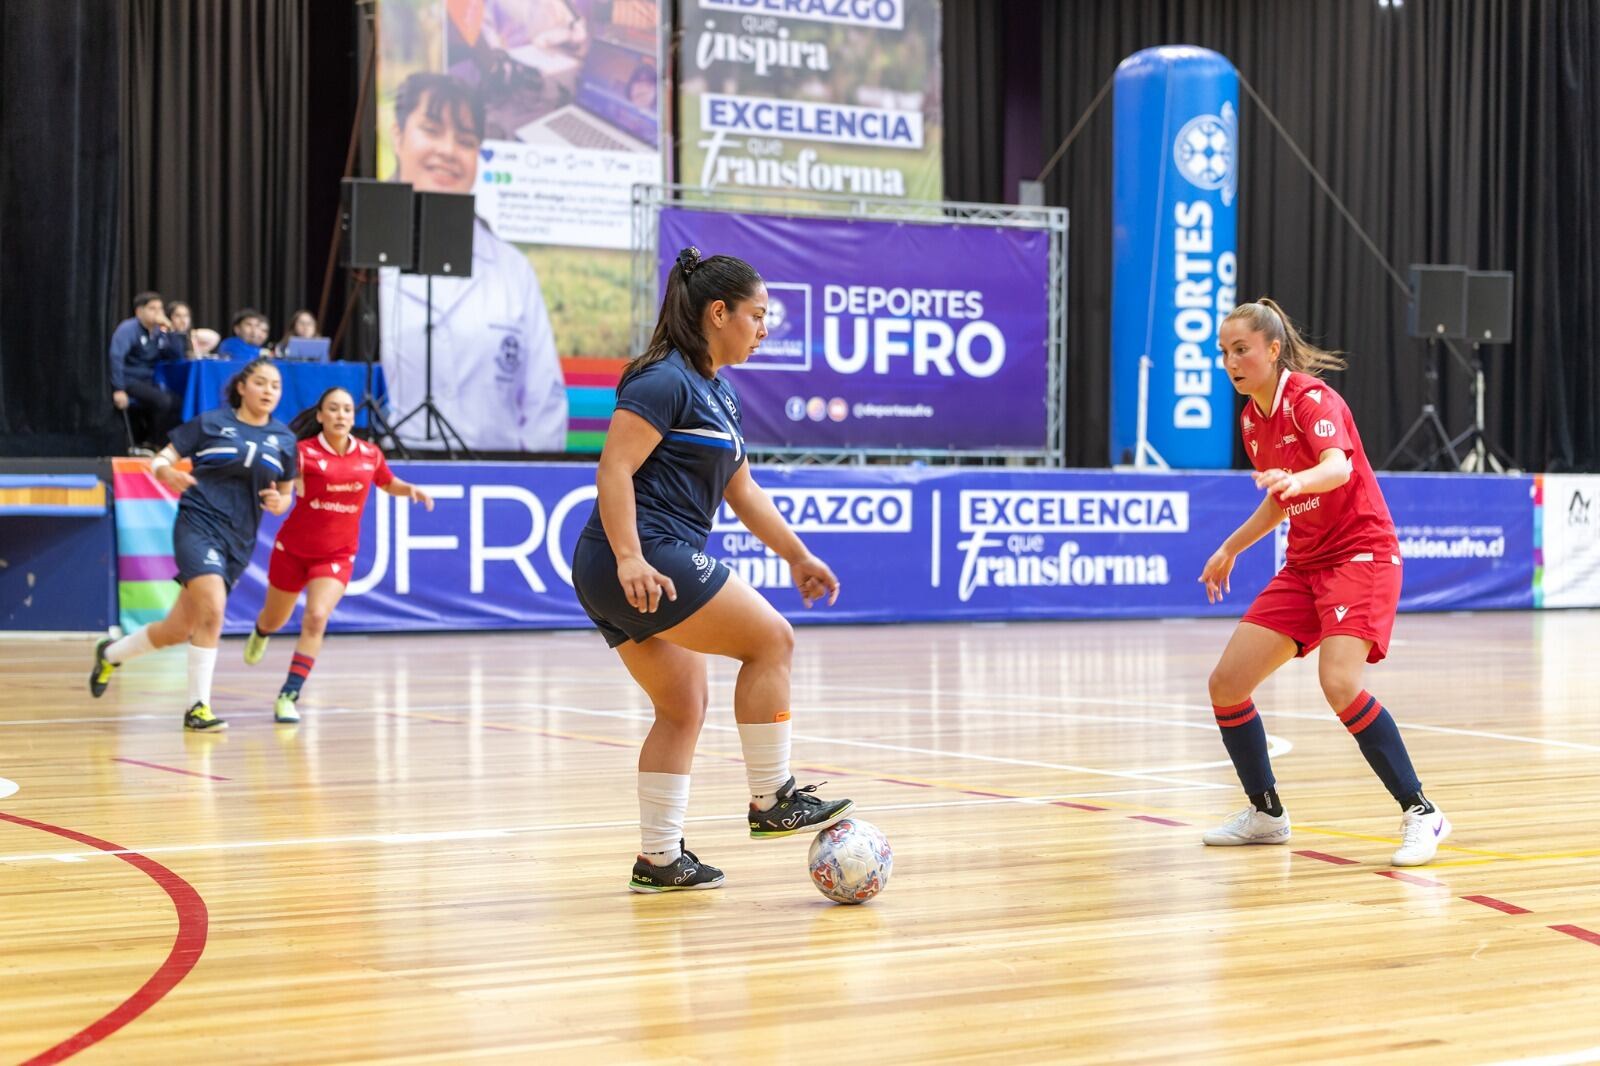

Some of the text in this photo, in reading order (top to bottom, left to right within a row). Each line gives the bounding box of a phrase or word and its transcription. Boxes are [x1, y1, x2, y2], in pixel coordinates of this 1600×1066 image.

[742, 15, 778, 34] que
[696, 20, 830, 76] inspira
[708, 99, 913, 142] EXCELENCIA
[697, 131, 905, 196] Transforma
[747, 137, 783, 155] que
[824, 284, 984, 319] DEPORTES
[1173, 201, 1213, 430] DEPORTES
[1215, 251, 1237, 370] RO
[823, 316, 1006, 378] UFRO
[1318, 422, 1333, 437] hp
[969, 497, 1178, 525] EXCELENCIA
[1283, 496, 1320, 517] ntander
[1007, 534, 1045, 557] que
[956, 531, 1170, 602] Transforma
